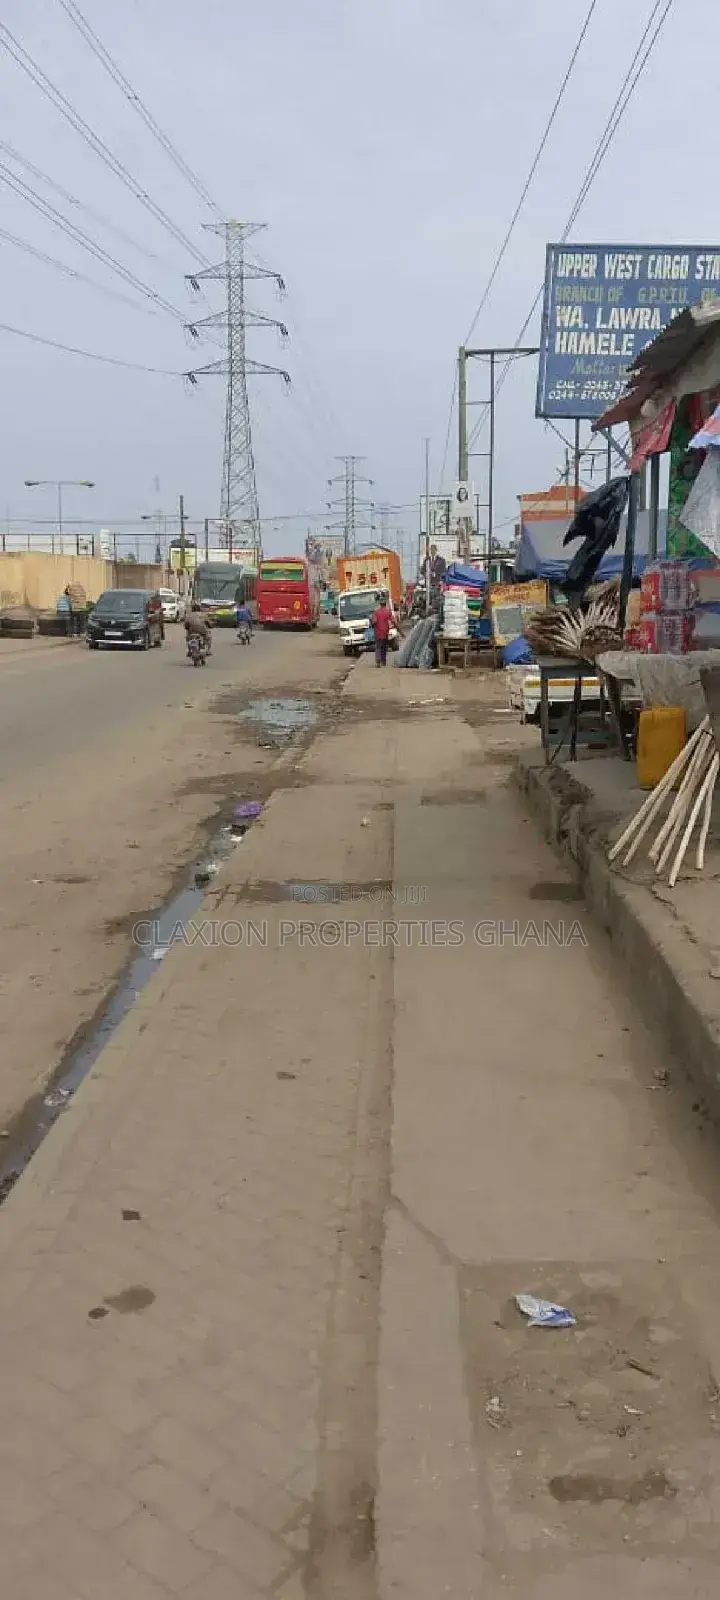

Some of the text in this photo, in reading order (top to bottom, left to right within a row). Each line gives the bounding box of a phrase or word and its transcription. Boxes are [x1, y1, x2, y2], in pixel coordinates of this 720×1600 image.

[557, 252, 598, 278] UPPER
[604, 253, 642, 279] WEST
[647, 254, 690, 280] CARGO
[555, 285, 603, 303] BRANCH
[607, 286, 624, 303] OF
[555, 331, 635, 355] HAMELE
